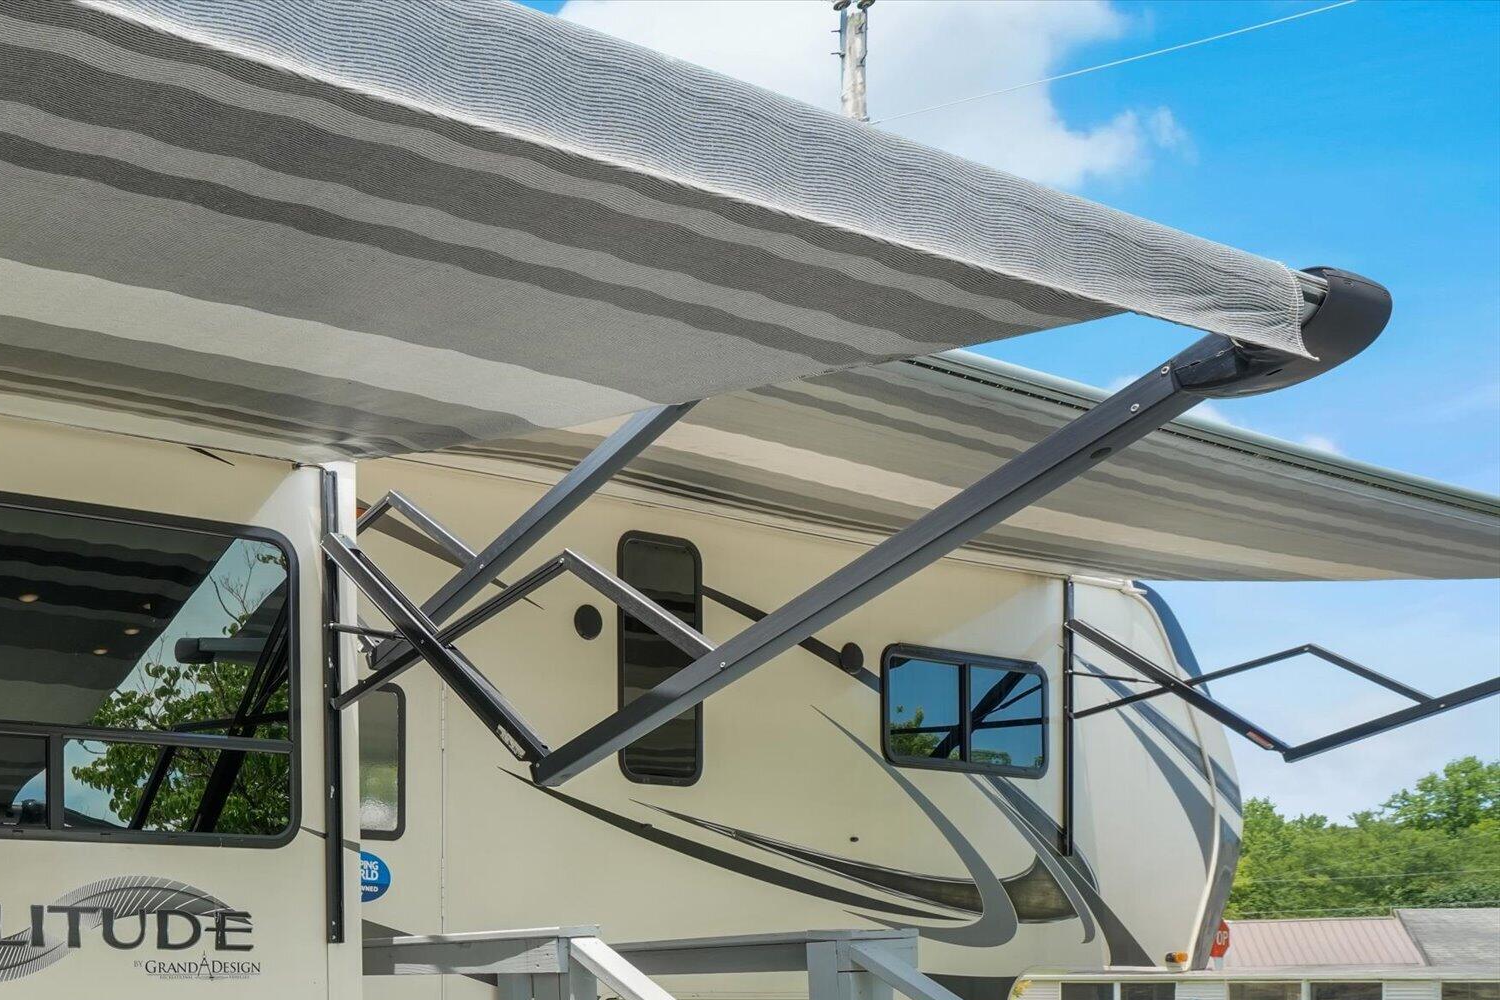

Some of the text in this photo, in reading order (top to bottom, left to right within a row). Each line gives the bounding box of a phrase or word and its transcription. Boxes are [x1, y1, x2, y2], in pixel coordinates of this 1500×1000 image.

[360, 861, 378, 870] PING
[360, 869, 379, 880] RLD
[1216, 930, 1228, 945] OP
[133, 959, 261, 974] BY GRAND DESIGN
